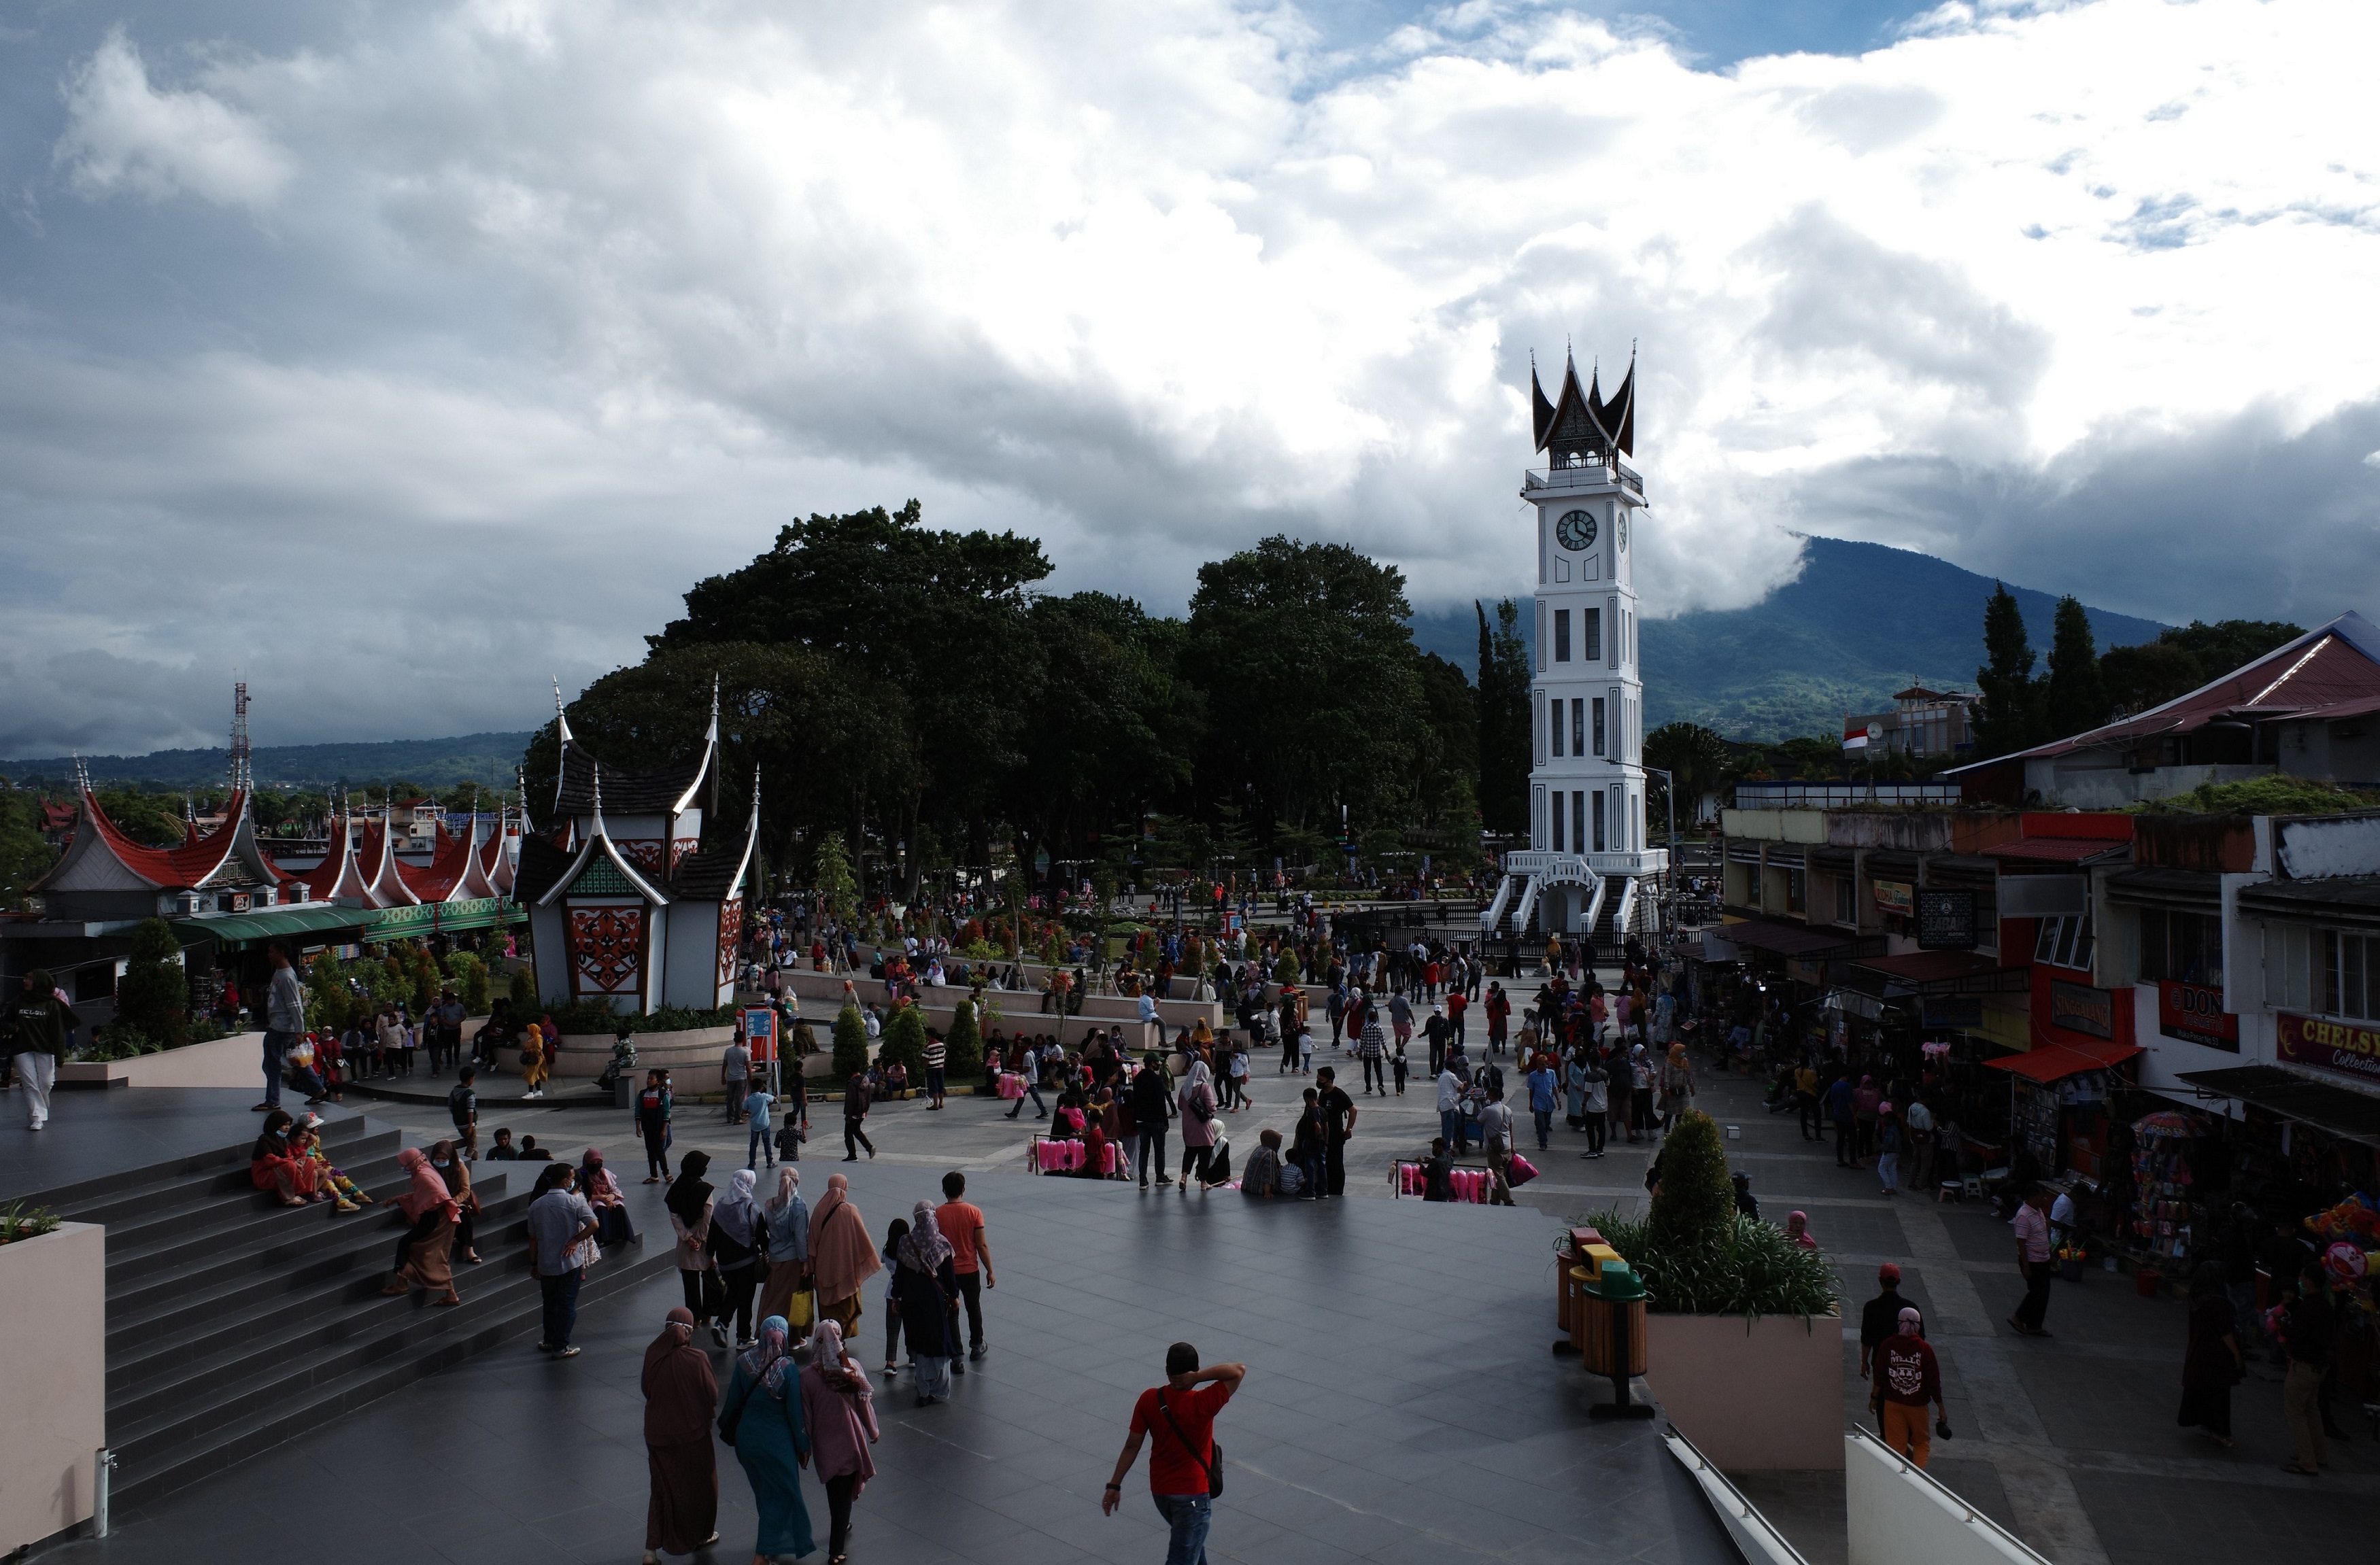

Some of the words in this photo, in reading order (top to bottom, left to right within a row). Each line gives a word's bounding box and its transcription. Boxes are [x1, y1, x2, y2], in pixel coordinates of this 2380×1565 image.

[1928, 916, 1966, 931] LABAH
[2056, 994, 2107, 1028] SINGGALANG
[2181, 986, 2224, 1021] DON
[2182, 1012, 2224, 1033] COSMETIC
